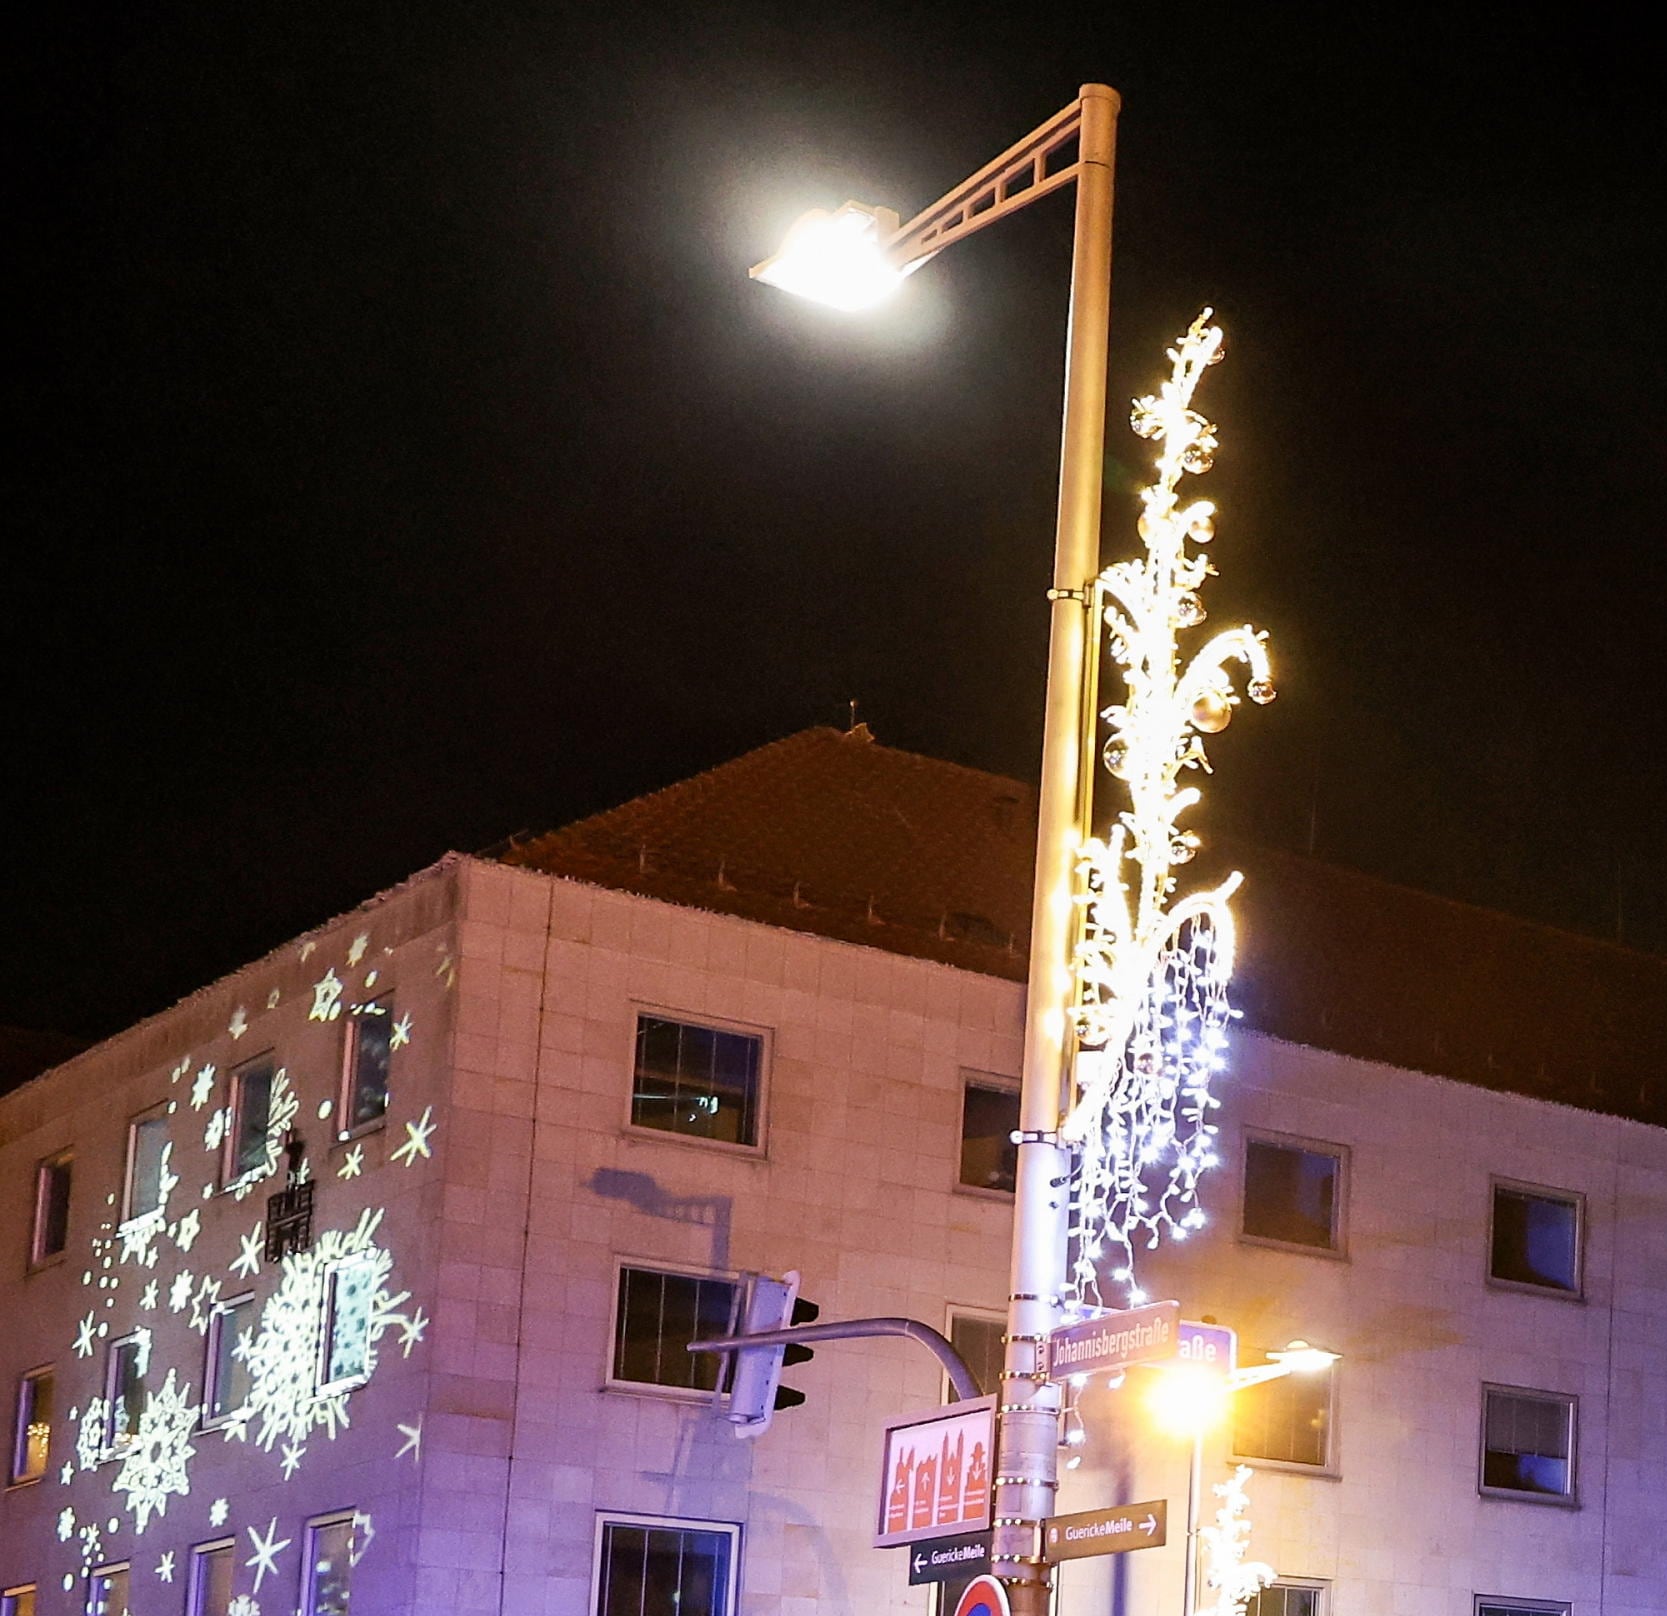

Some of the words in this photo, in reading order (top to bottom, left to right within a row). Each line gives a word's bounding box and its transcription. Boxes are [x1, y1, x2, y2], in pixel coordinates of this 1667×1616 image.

[1053, 1317, 1169, 1367] Johannisbergstraße
[1065, 1517, 1133, 1541] GuerickeMeile
[931, 1543, 985, 1565] GuerickeMeile
